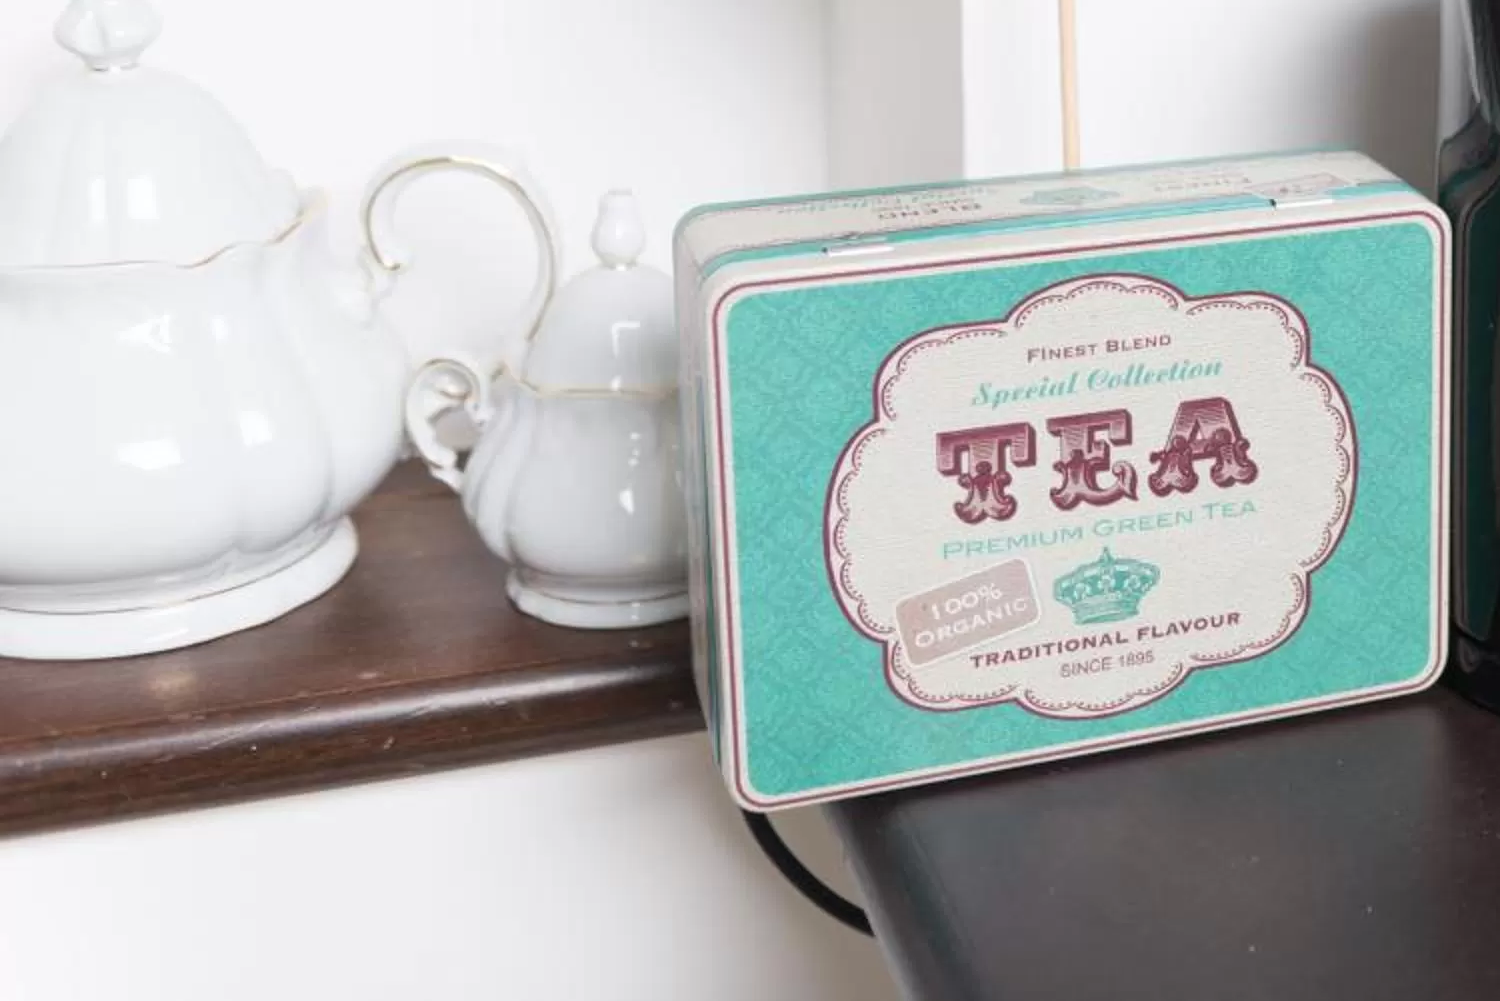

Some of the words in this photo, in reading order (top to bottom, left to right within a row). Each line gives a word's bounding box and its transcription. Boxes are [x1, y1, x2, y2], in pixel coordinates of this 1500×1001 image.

[1027, 344, 1098, 364] FINEST
[1105, 334, 1172, 353] BLEND
[971, 371, 1080, 410] Special
[1086, 359, 1224, 391] Collection
[935, 396, 1259, 525] TEA
[942, 526, 1084, 560] PREMIUM
[1093, 507, 1193, 539] GREEN
[1202, 500, 1257, 522] TEA
[914, 598, 1028, 648] ORGANIC
[930, 583, 1003, 620] 100%
[970, 631, 1129, 669] TRADITIONAL
[1136, 611, 1242, 641] FLAVOUR
[1059, 660, 1113, 679] SINCE
[1118, 651, 1155, 672] 1895
